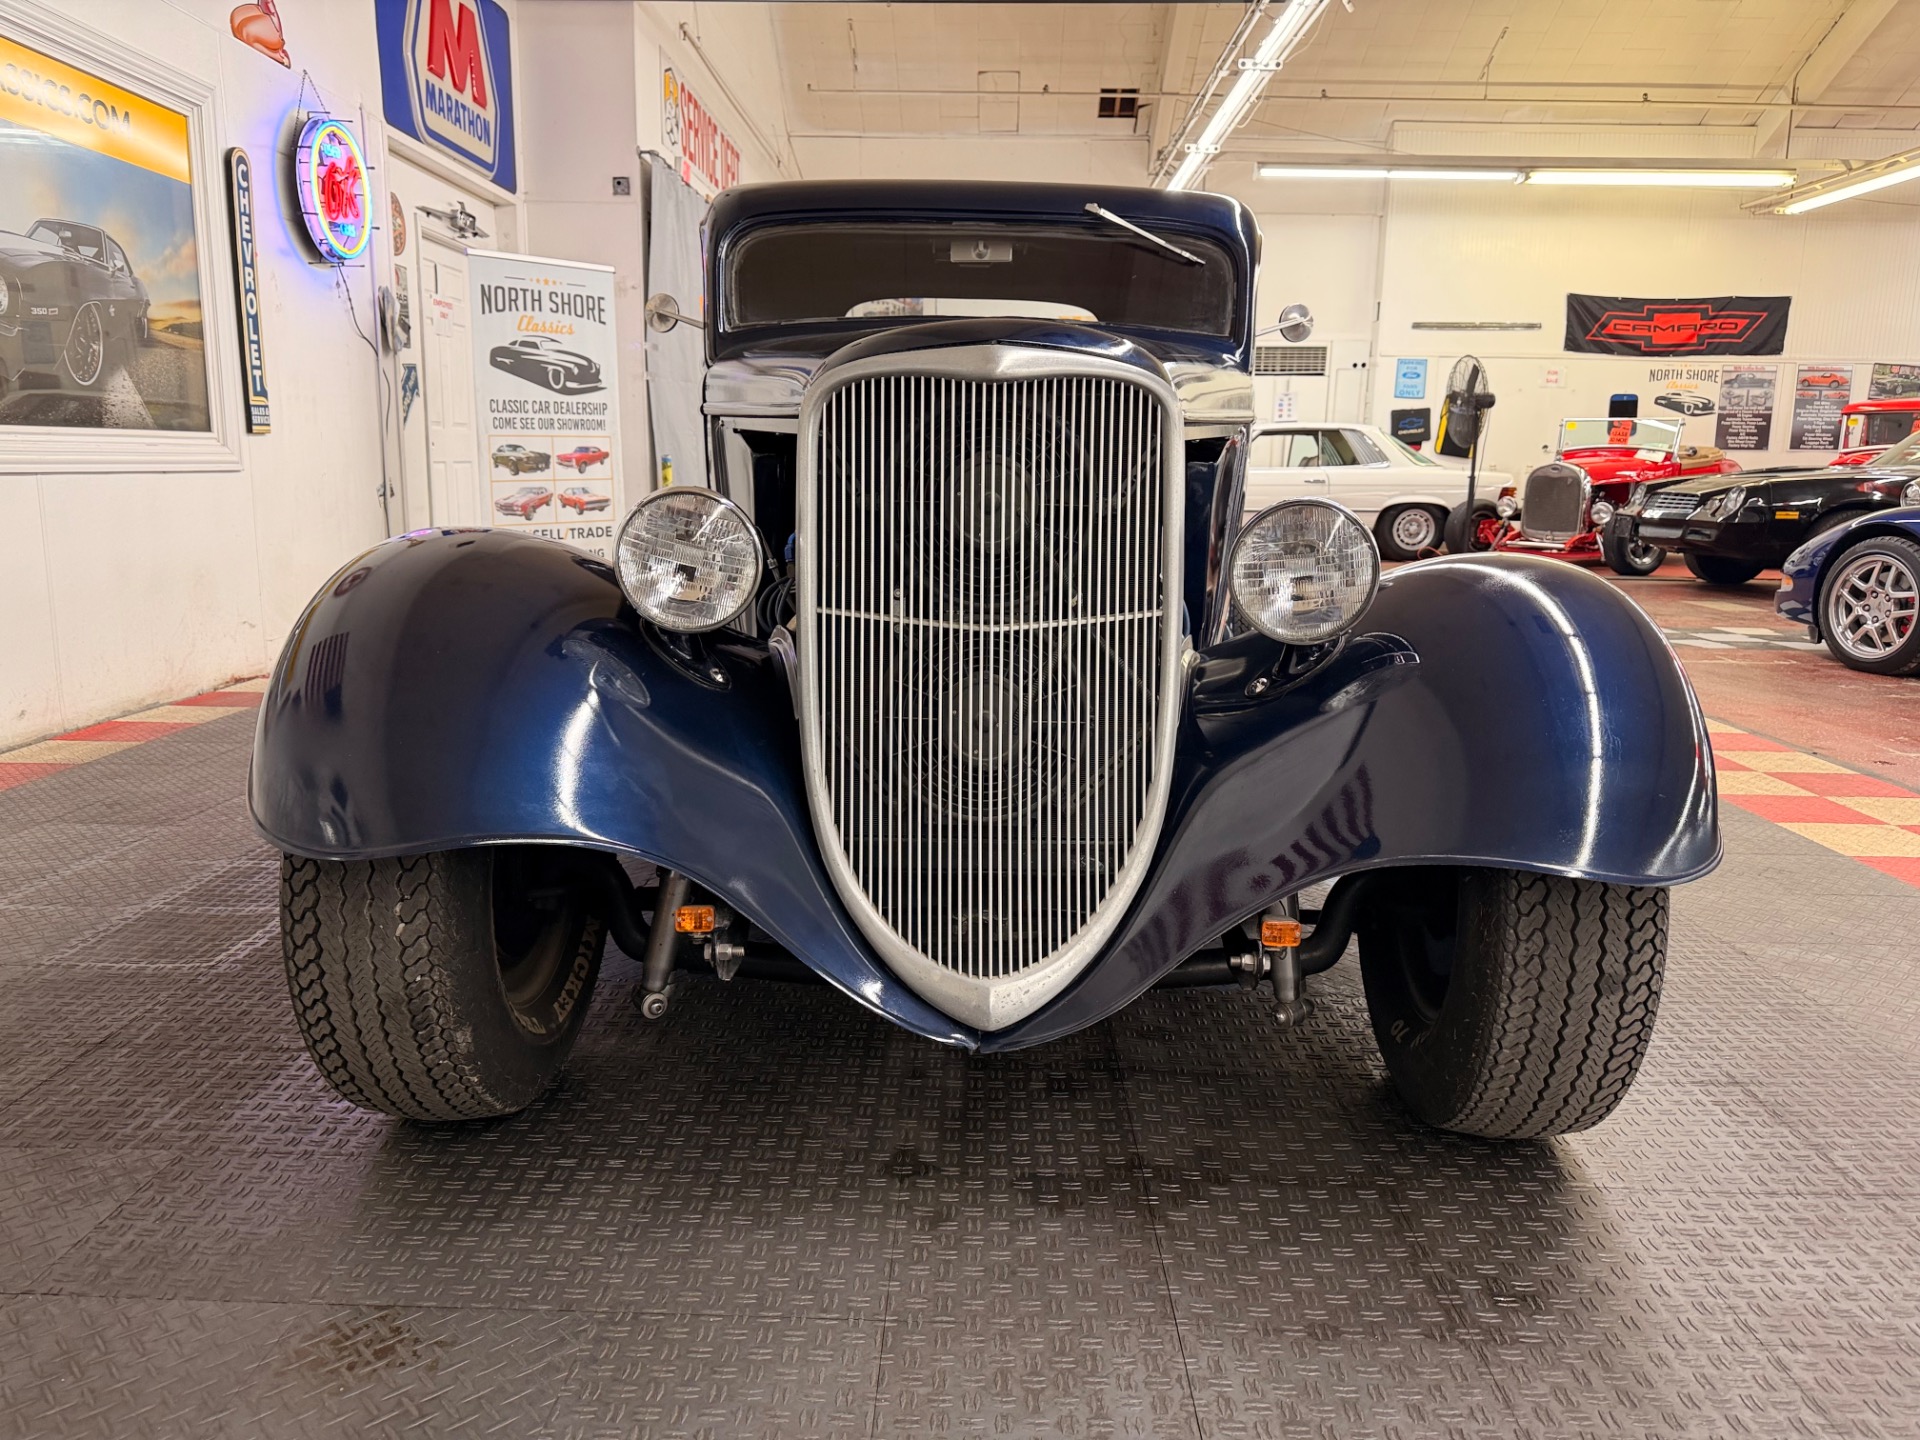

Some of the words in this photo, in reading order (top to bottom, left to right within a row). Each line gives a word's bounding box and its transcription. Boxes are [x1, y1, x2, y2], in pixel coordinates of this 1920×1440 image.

[427, 0, 487, 111] M
[0, 63, 131, 136] SSICS.COM
[425, 79, 491, 147] MARATHON
[680, 82, 719, 190] SERVICE
[237, 162, 263, 392] CHEVROLET
[30, 307, 48, 315] 350
[480, 283, 542, 315] NORTH
[549, 291, 606, 325] SHORE
[517, 314, 575, 335] Classics
[1613, 322, 1738, 333] CAMARO
[1649, 369, 1683, 382] NORTH
[1686, 369, 1720, 384] SHORE
[489, 399, 529, 414] CLASSIC
[532, 400, 550, 414] CAR
[553, 401, 608, 416] DEALERSHIP
[492, 416, 518, 430] COME
[520, 417, 535, 430] SEE
[538, 418, 555, 430] OUR
[557, 418, 606, 431] SHOWROOM!
